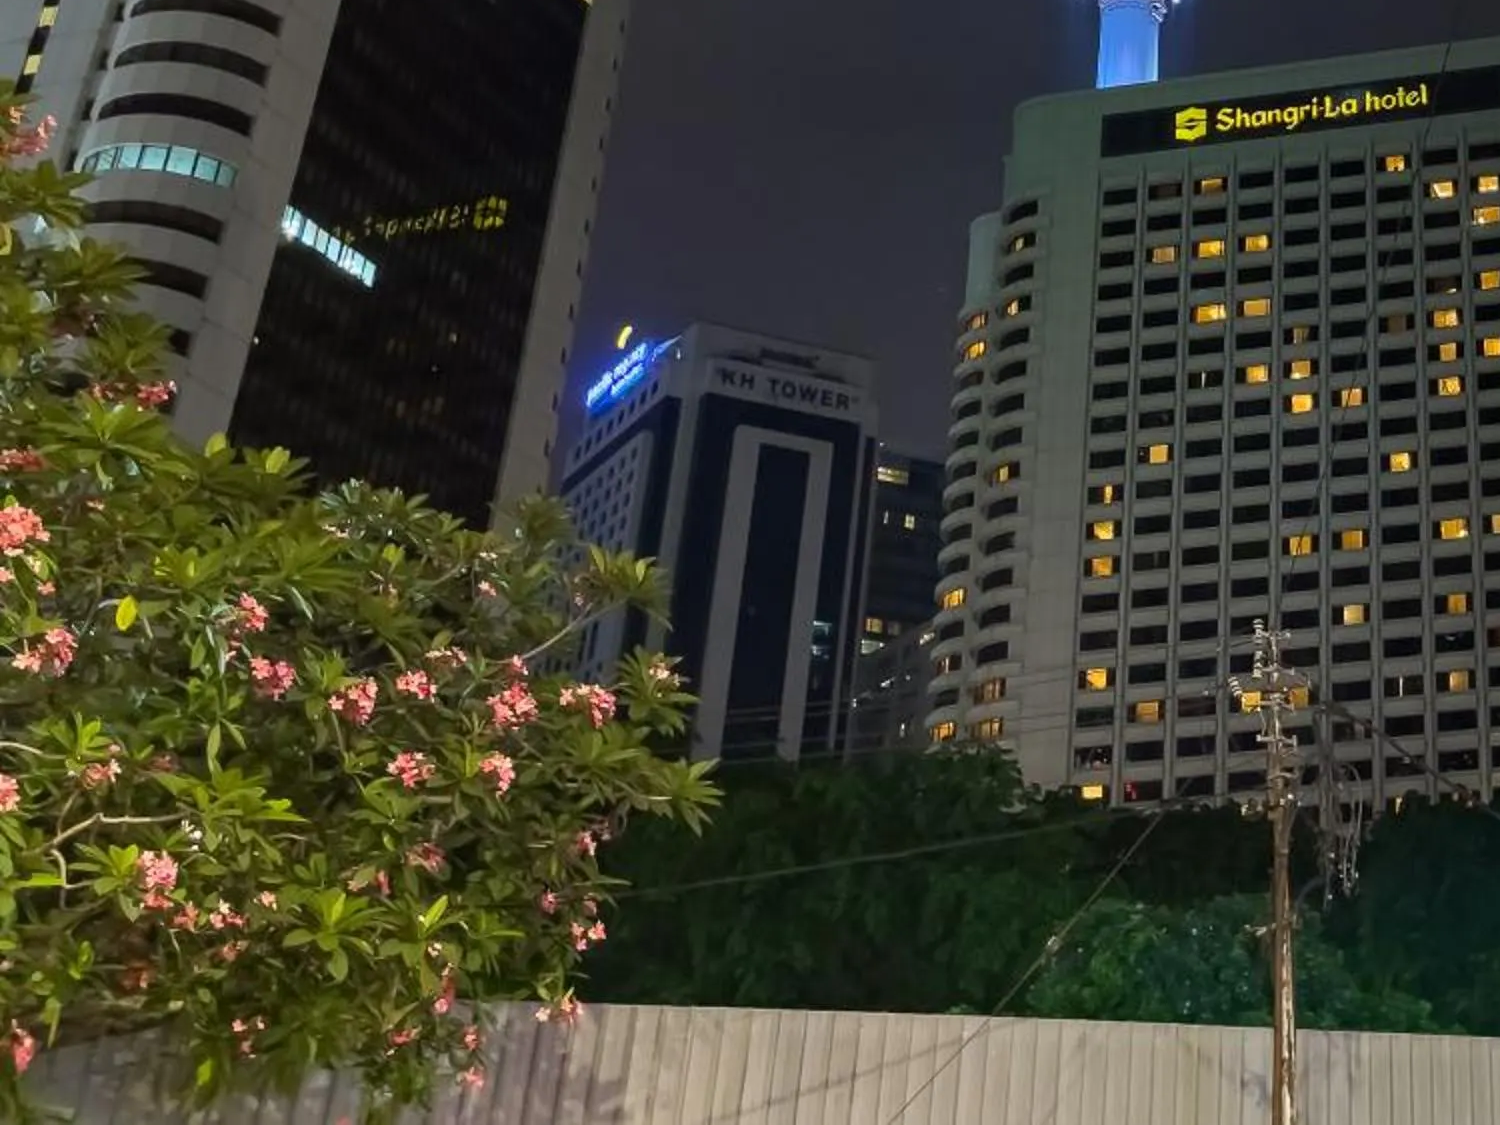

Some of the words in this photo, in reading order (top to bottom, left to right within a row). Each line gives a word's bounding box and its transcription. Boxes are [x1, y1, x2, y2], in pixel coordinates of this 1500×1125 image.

[1215, 94, 1358, 132] Shangri-La
[1365, 82, 1428, 113] hotel
[766, 377, 850, 411] TOWER
